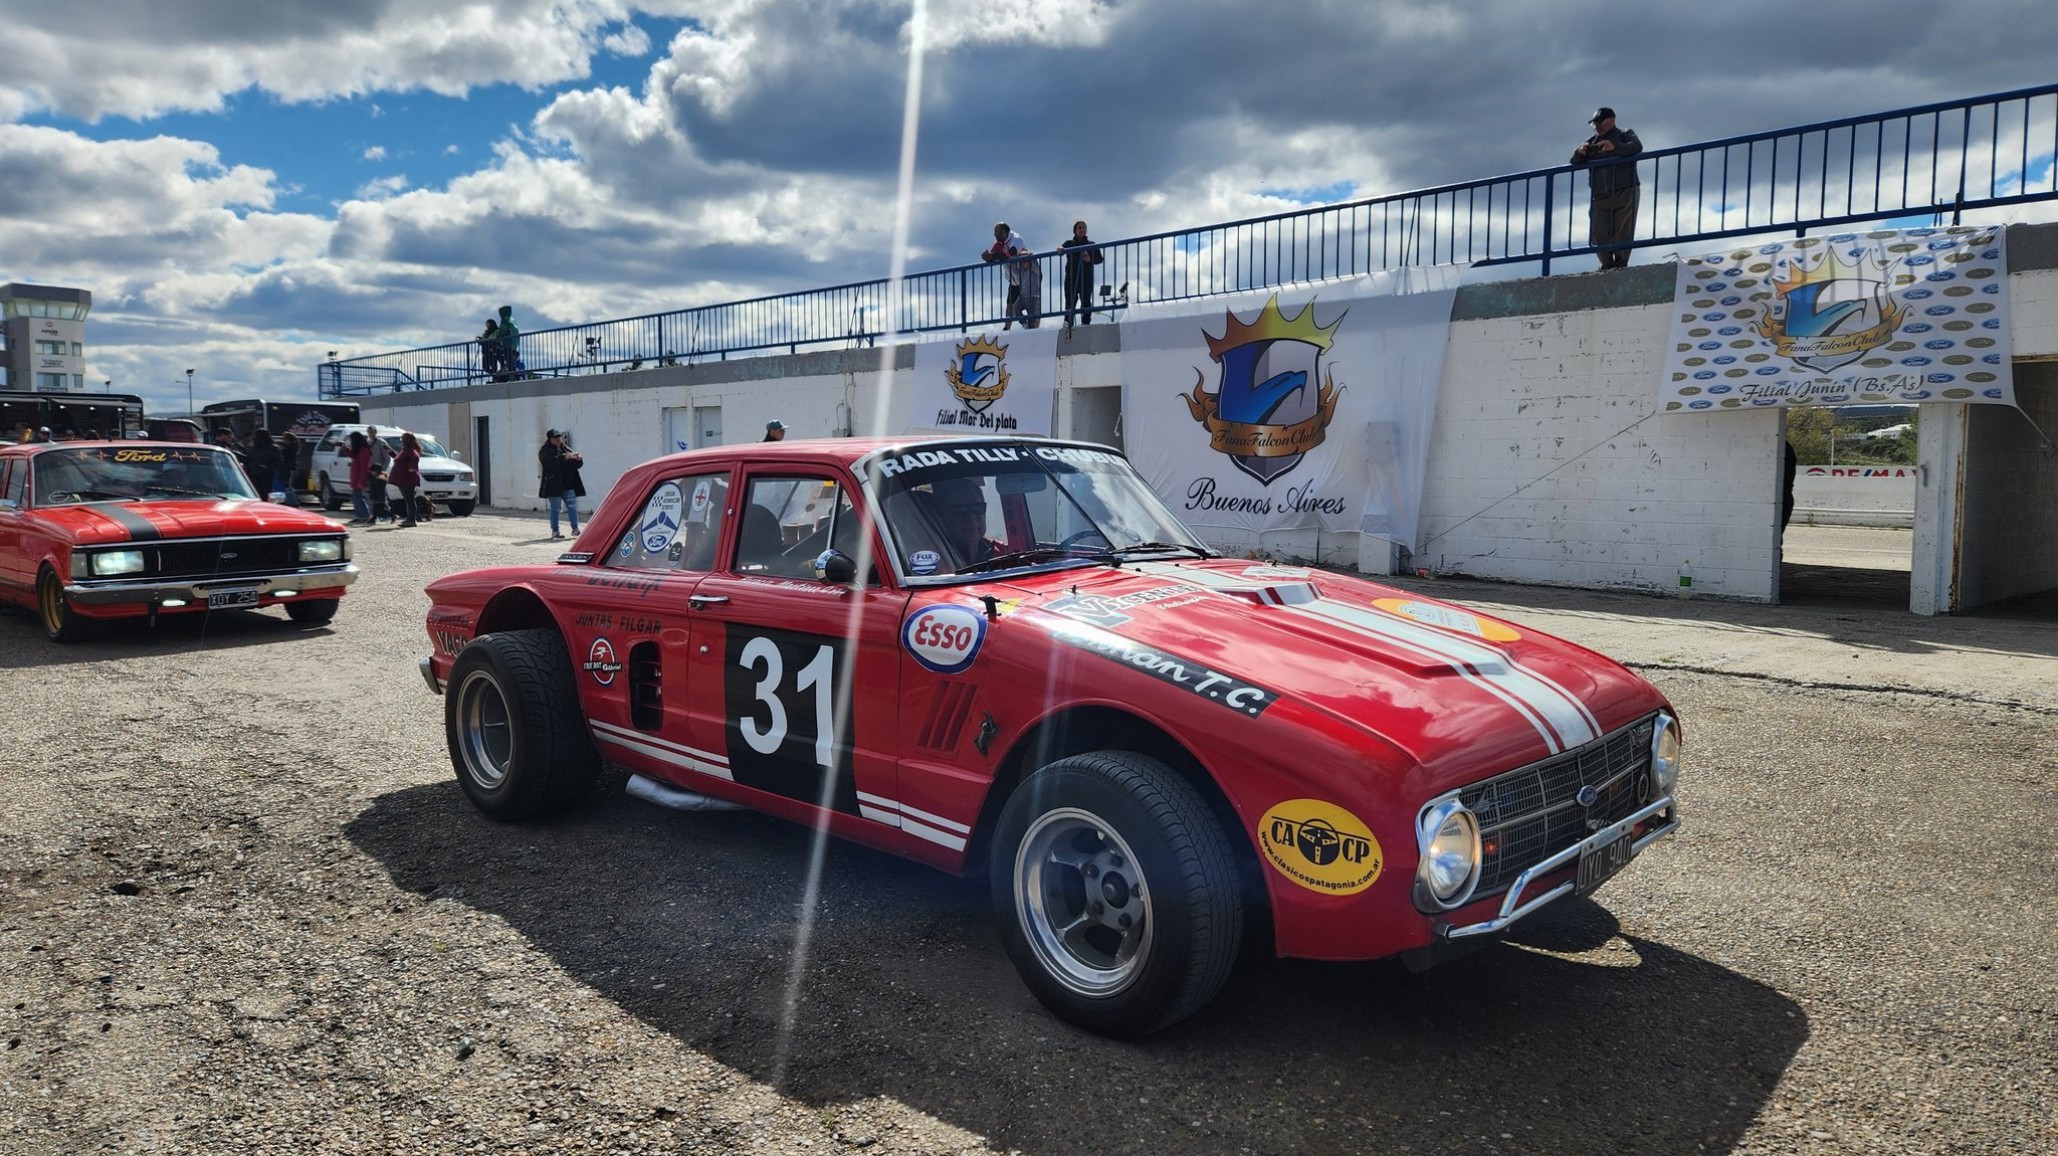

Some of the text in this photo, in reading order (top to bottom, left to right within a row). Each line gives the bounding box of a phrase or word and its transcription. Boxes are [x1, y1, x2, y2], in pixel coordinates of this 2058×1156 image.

[1739, 383, 1791, 402] Filial
[980, 412, 994, 428] Del
[114, 450, 167, 462] Ford
[877, 450, 957, 478] RADA
[955, 447, 1021, 465] TILLY
[1185, 476, 1346, 515] Buenos Aires
[916, 553, 934, 561] FOX
[211, 594, 231, 605] XOY
[576, 612, 662, 634] JUNTAS FILGAR
[738, 635, 834, 768] 31
[1194, 671, 1265, 713] T.C.
[1271, 820, 1295, 847] CA
[1261, 830, 1380, 890] www.clasicospatagonia.com.ar
[1342, 837, 1370, 865] CP
